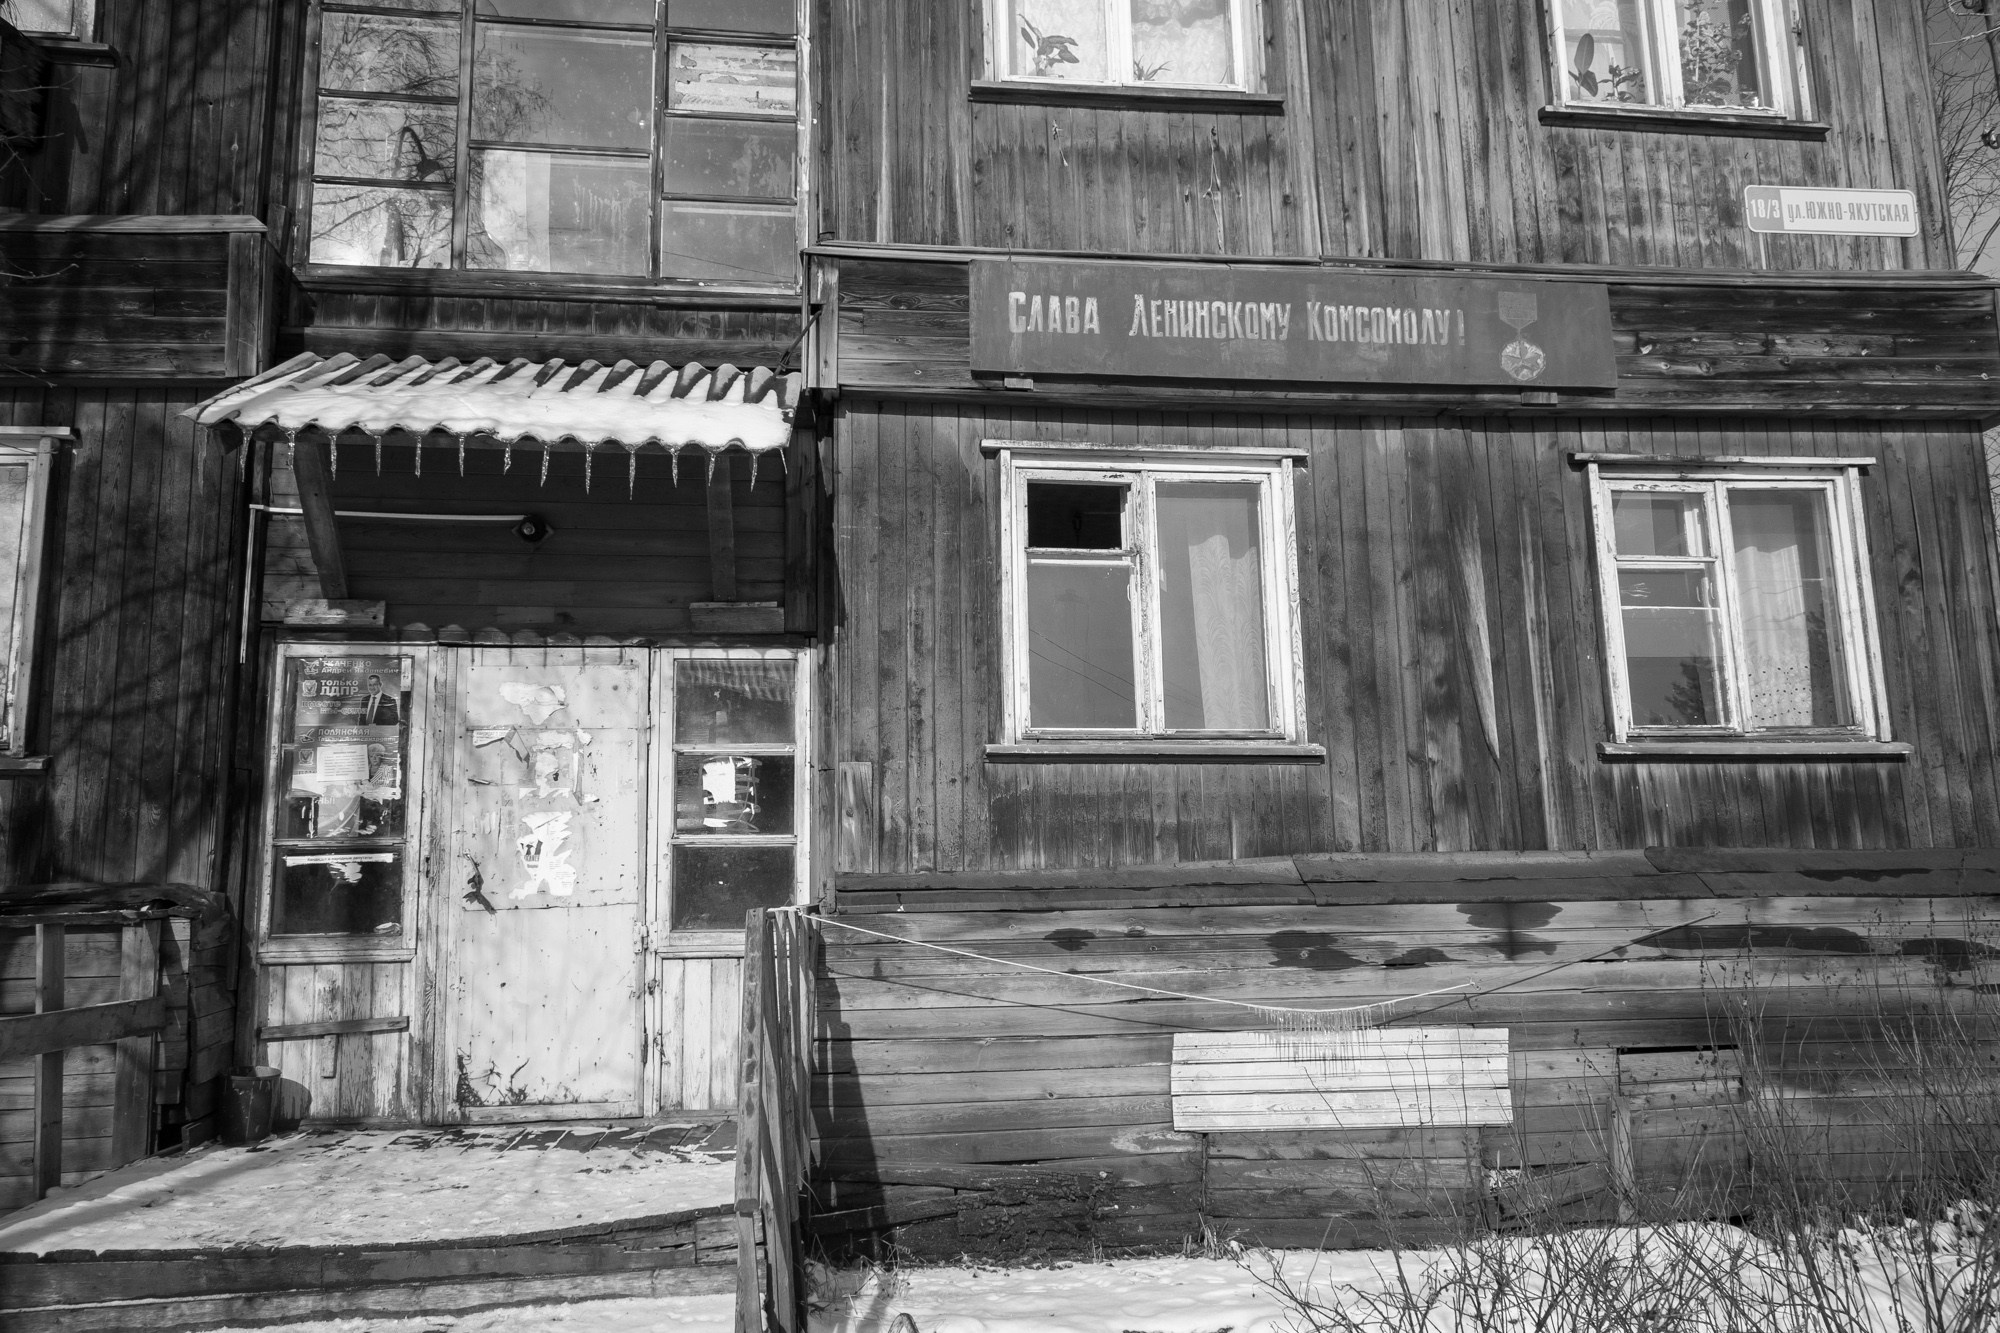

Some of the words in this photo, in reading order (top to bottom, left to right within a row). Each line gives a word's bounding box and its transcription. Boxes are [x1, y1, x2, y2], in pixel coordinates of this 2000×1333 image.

[1750, 199, 1781, 220] 18/3
[1008, 292, 1101, 334] СЛАВА
[1128, 294, 1292, 341] ЛЕНИНСКОМУ
[320, 686, 359, 696] ЛДПР
[318, 728, 370, 736] ПОЛЯНСКАЯ
